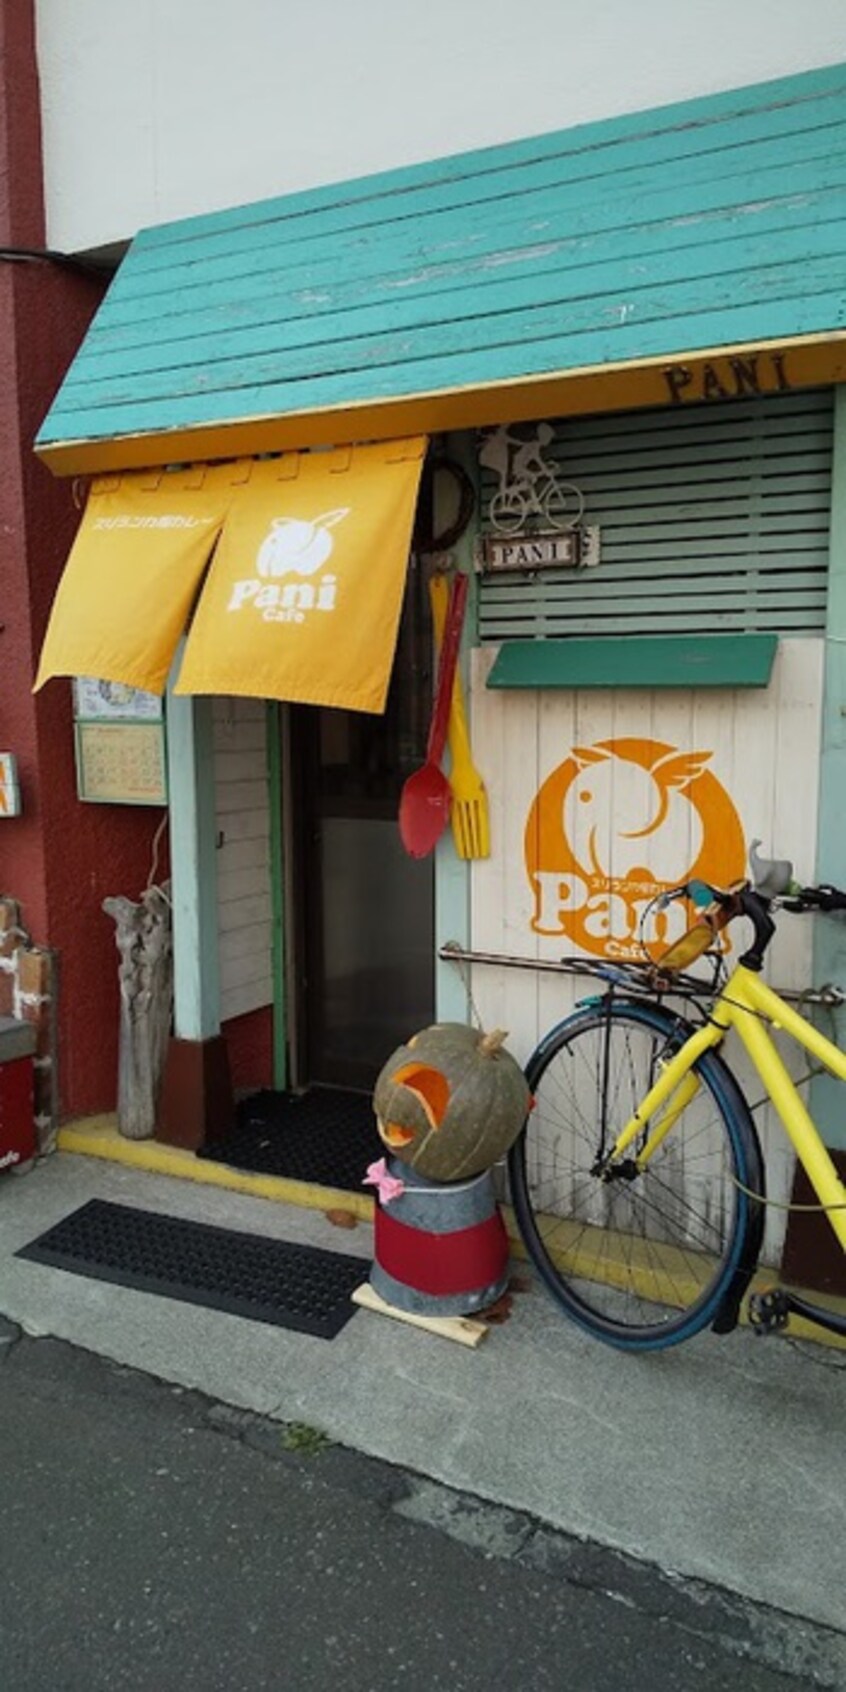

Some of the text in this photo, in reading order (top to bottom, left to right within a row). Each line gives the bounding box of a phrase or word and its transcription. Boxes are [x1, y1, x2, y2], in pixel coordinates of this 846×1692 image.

[661, 351, 792, 402] PANI
[502, 542, 558, 563] PANI
[227, 575, 337, 611] Pani
[262, 607, 305, 624] Cafe
[533, 871, 724, 953] Pan
